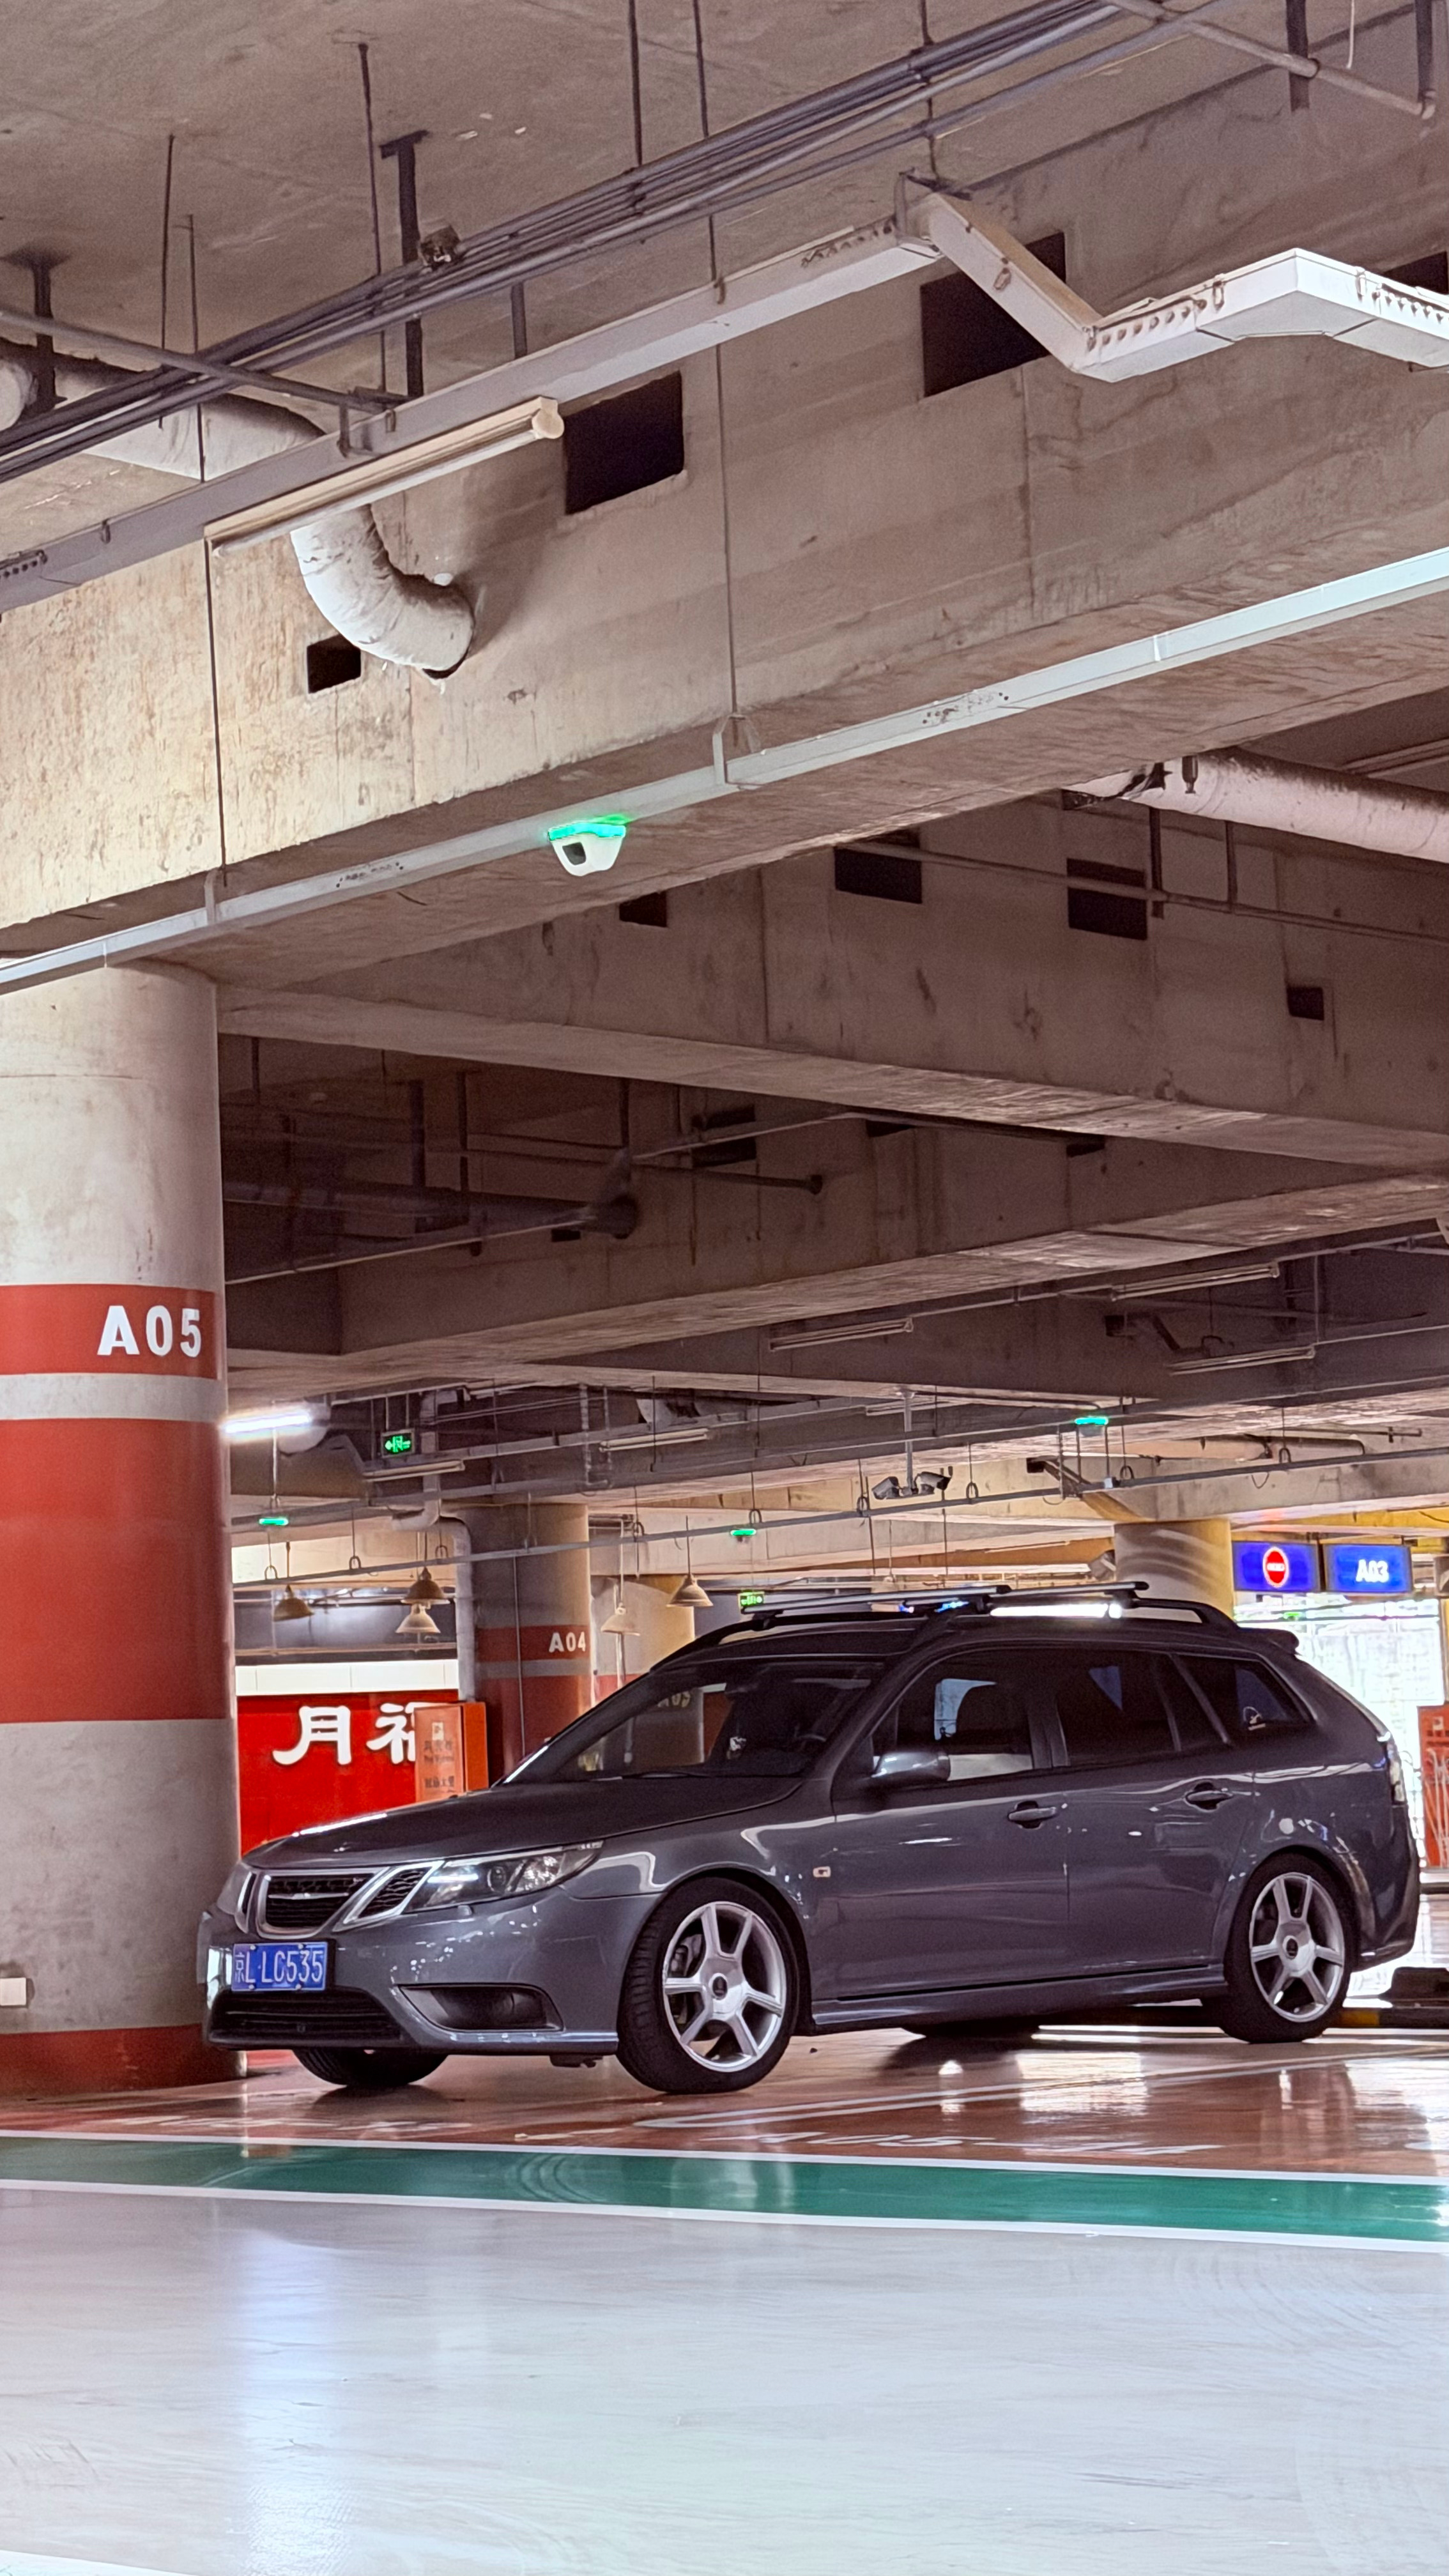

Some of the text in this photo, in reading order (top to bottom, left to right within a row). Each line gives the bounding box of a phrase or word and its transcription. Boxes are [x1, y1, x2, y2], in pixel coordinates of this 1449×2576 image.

[96, 1305, 202, 1358] A05
[1355, 1559, 1390, 1583] A03
[548, 1631, 586, 1653] A04
